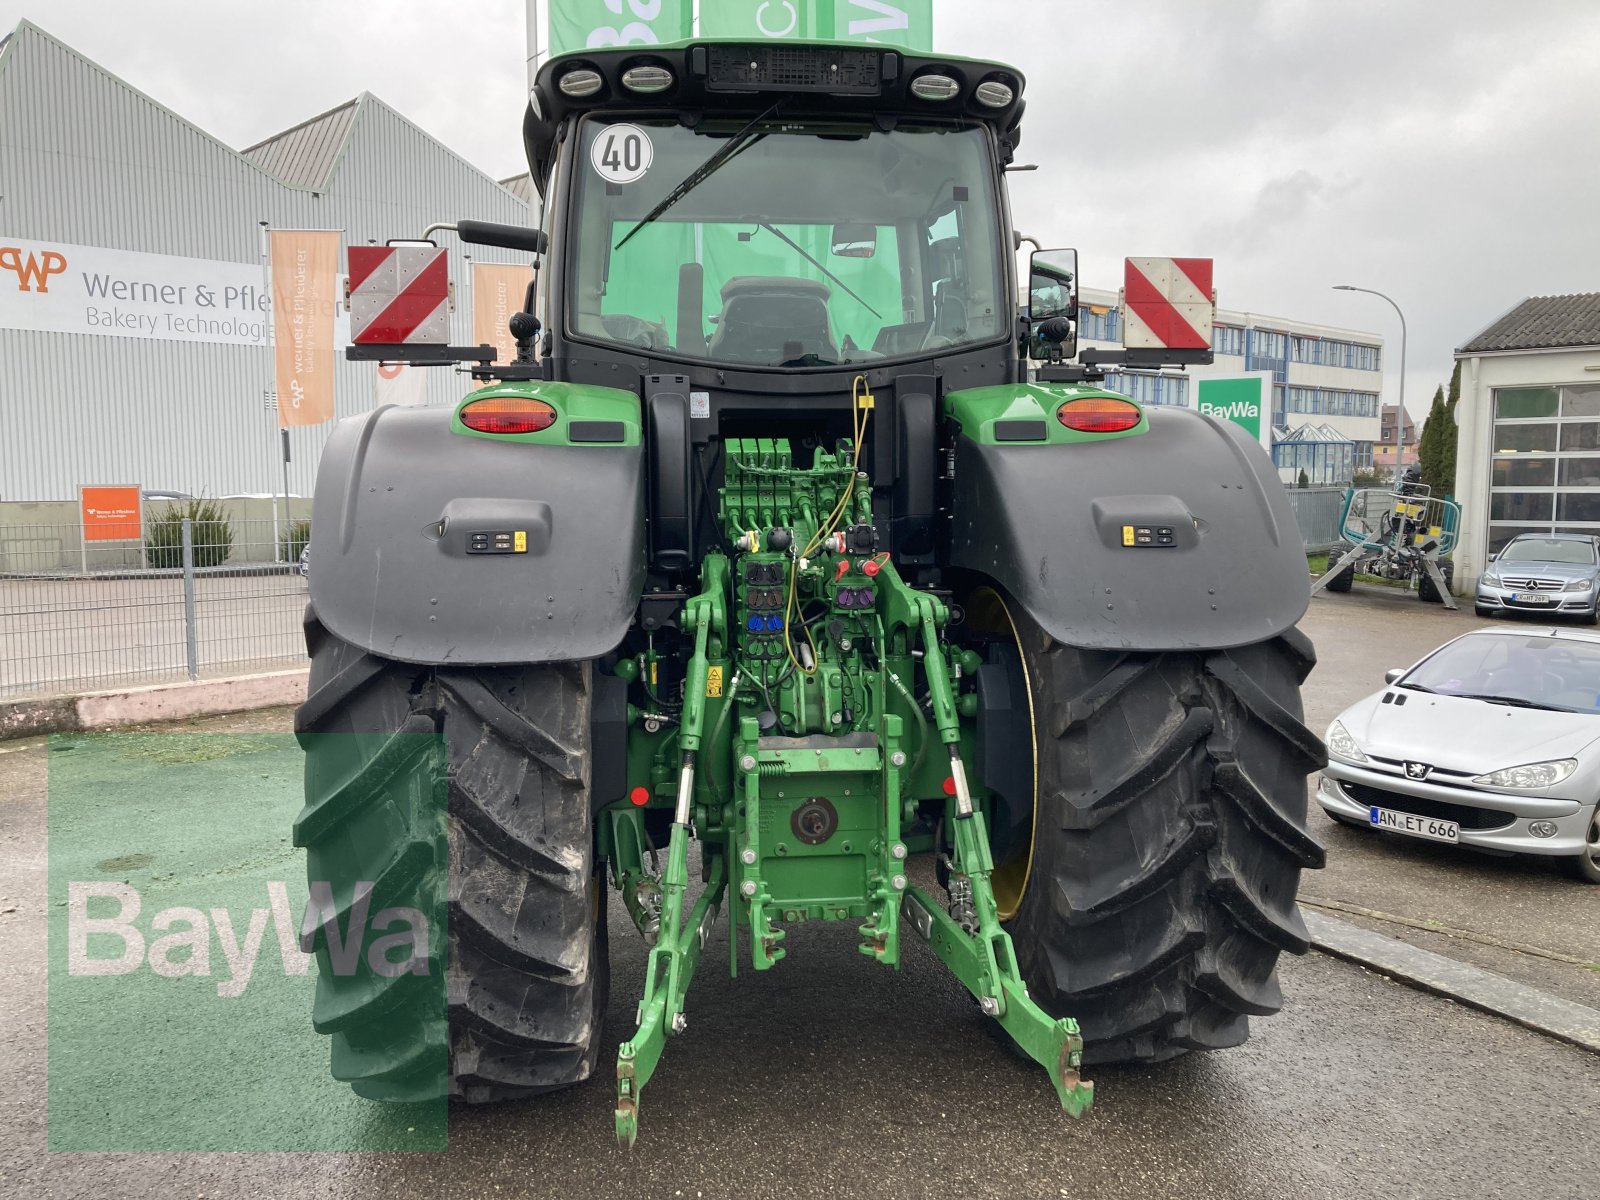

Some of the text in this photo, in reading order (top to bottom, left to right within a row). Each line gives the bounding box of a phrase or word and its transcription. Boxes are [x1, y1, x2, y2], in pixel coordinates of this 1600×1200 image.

[602, 134, 640, 171] 40
[82, 272, 187, 305] Werner
[195, 284, 216, 307] &
[86, 306, 157, 334] Bakery
[1200, 402, 1258, 419] BayWa
[1379, 811, 1456, 838] AN ET 666
